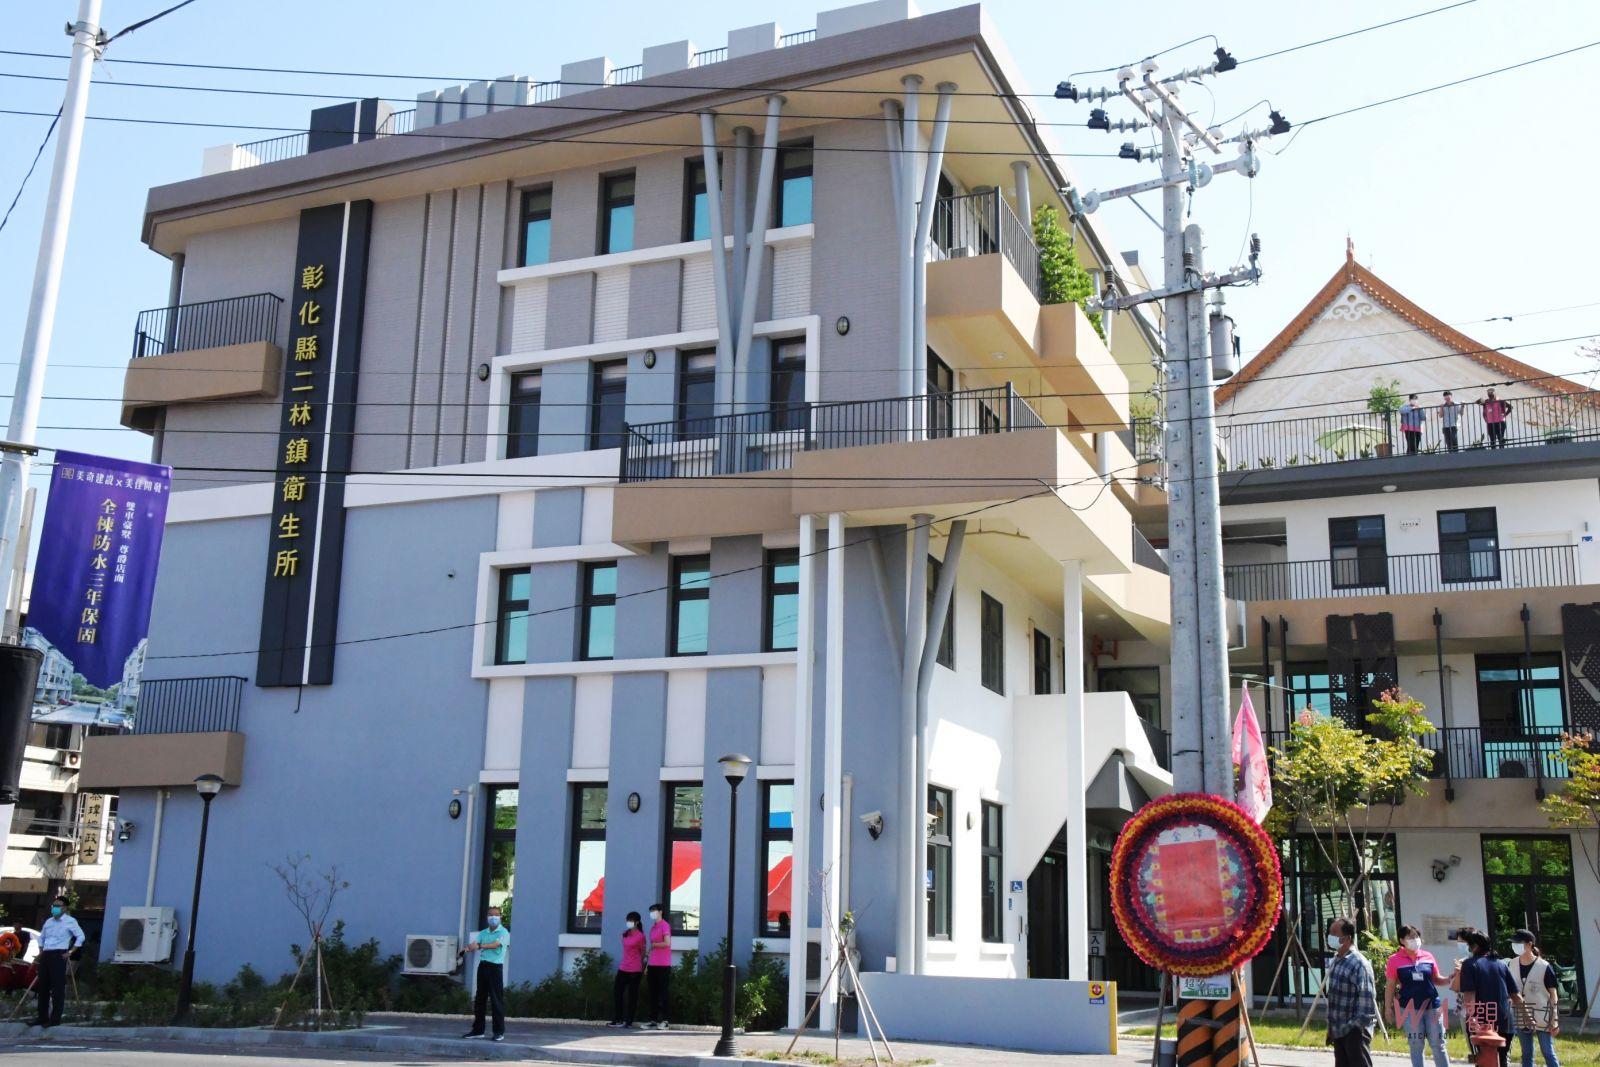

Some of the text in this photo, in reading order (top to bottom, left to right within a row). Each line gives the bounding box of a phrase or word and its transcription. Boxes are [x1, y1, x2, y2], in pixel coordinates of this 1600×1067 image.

[273, 263, 325, 578] 彰化縣二林鎮衛生所
[77, 498, 118, 644] 全棟防水三年保固
[1090, 935, 1100, 956] 入口
